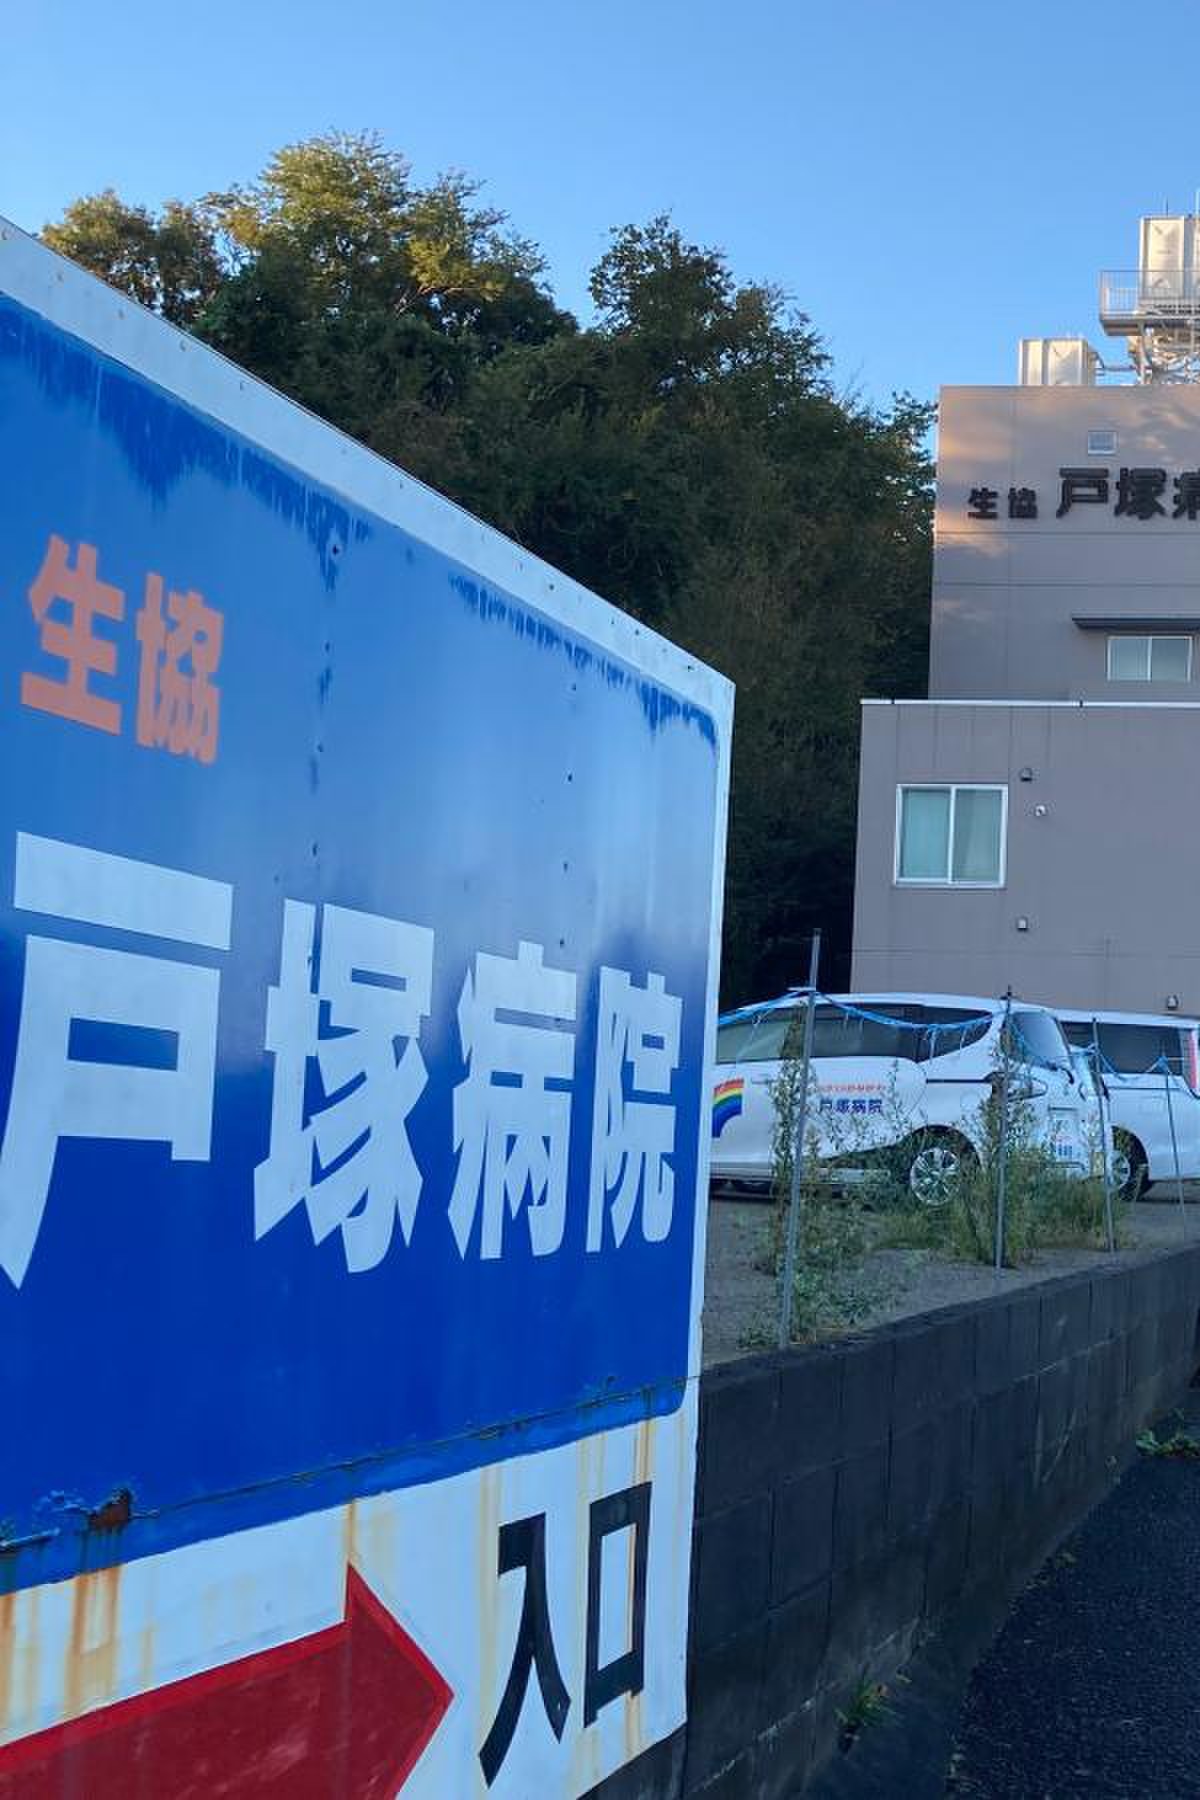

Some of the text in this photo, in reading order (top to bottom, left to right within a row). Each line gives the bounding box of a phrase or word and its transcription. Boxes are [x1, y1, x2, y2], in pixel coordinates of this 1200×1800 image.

[967, 487, 1038, 520] 生協
[20, 534, 224, 765] 生協
[0, 831, 683, 1290] 戸塚病院
[478, 1481, 653, 1789] 入口
